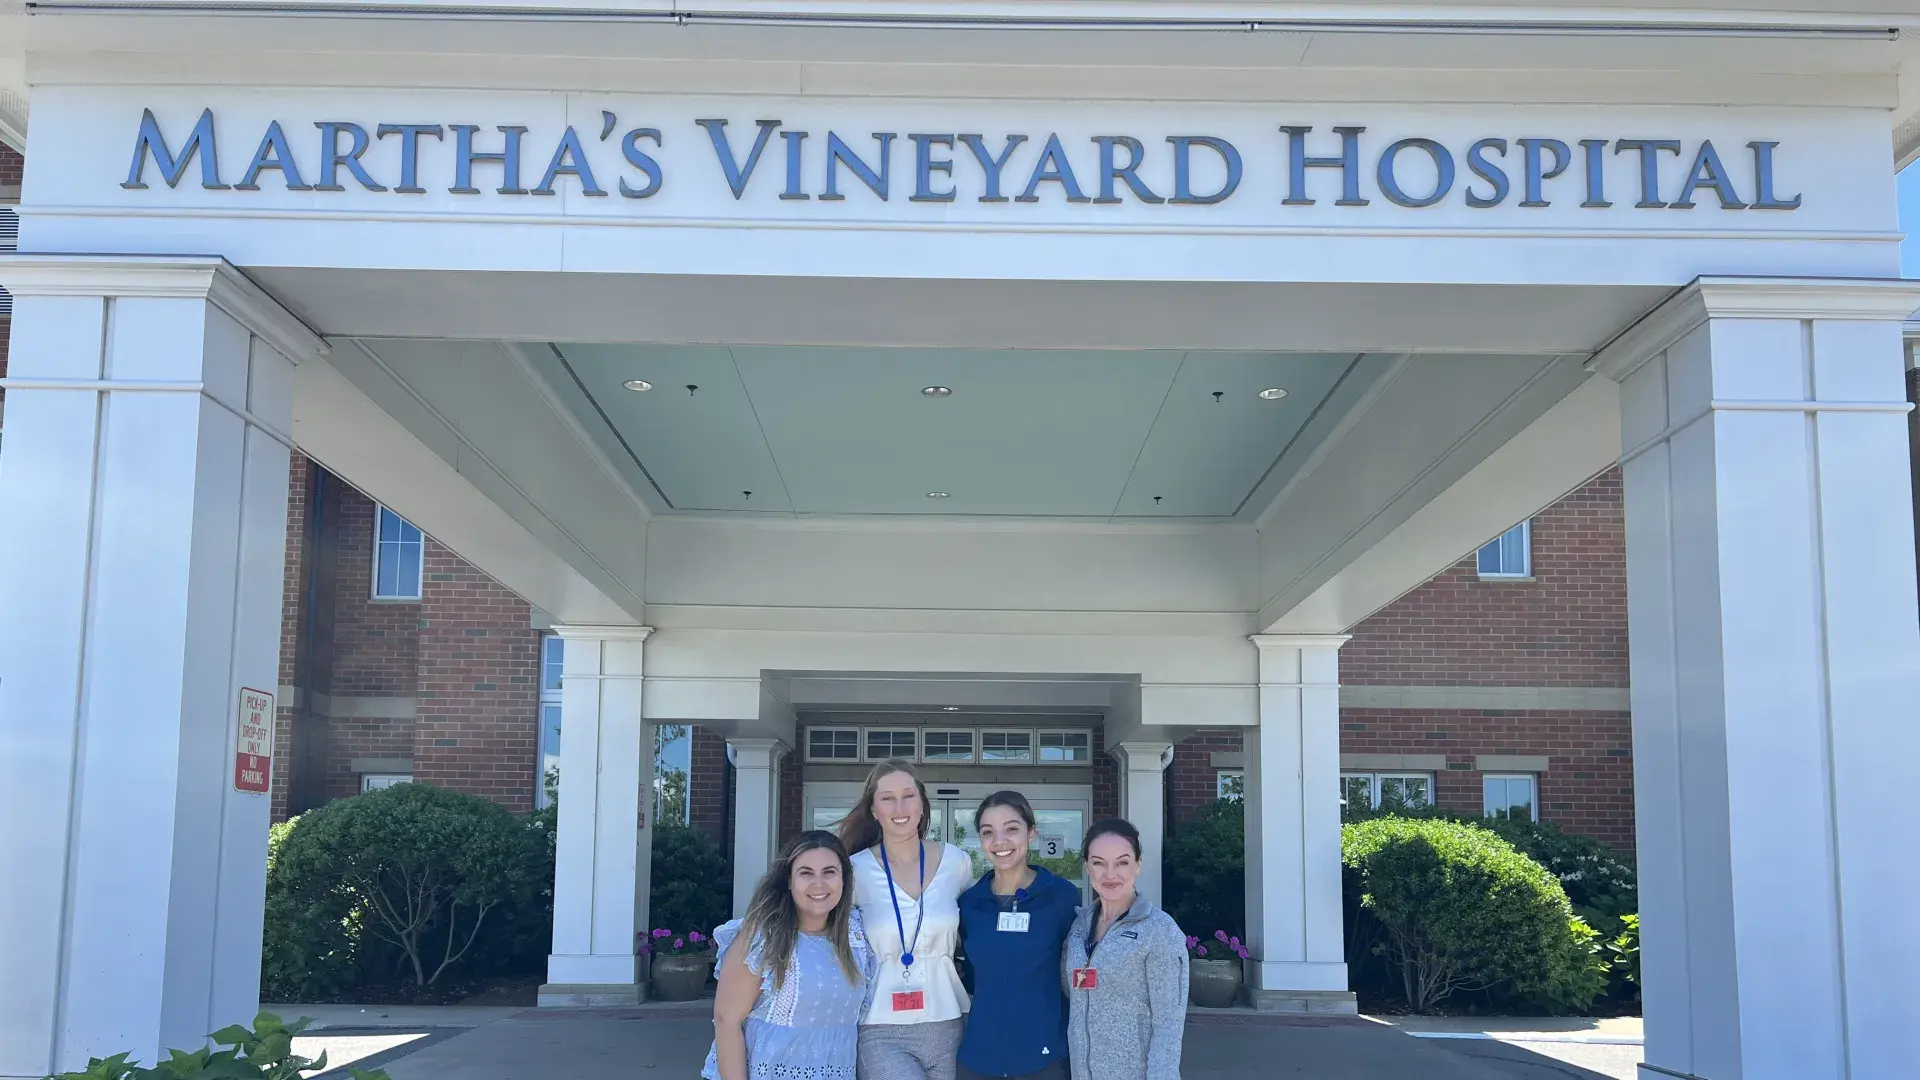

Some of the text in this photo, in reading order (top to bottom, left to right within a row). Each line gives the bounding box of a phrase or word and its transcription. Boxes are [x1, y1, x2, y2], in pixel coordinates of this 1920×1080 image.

[120, 107, 1802, 211] MARTHA'S VINEYARD HOSPITAL
[246, 696, 267, 712] PICK-UP
[250, 712, 261, 725] AND
[242, 725, 267, 741] DROP-OFF
[248, 741, 260, 754] ONLY
[249, 756, 258, 769] NO
[241, 769, 264, 784] PARKING
[1047, 841, 1057, 855] 3
